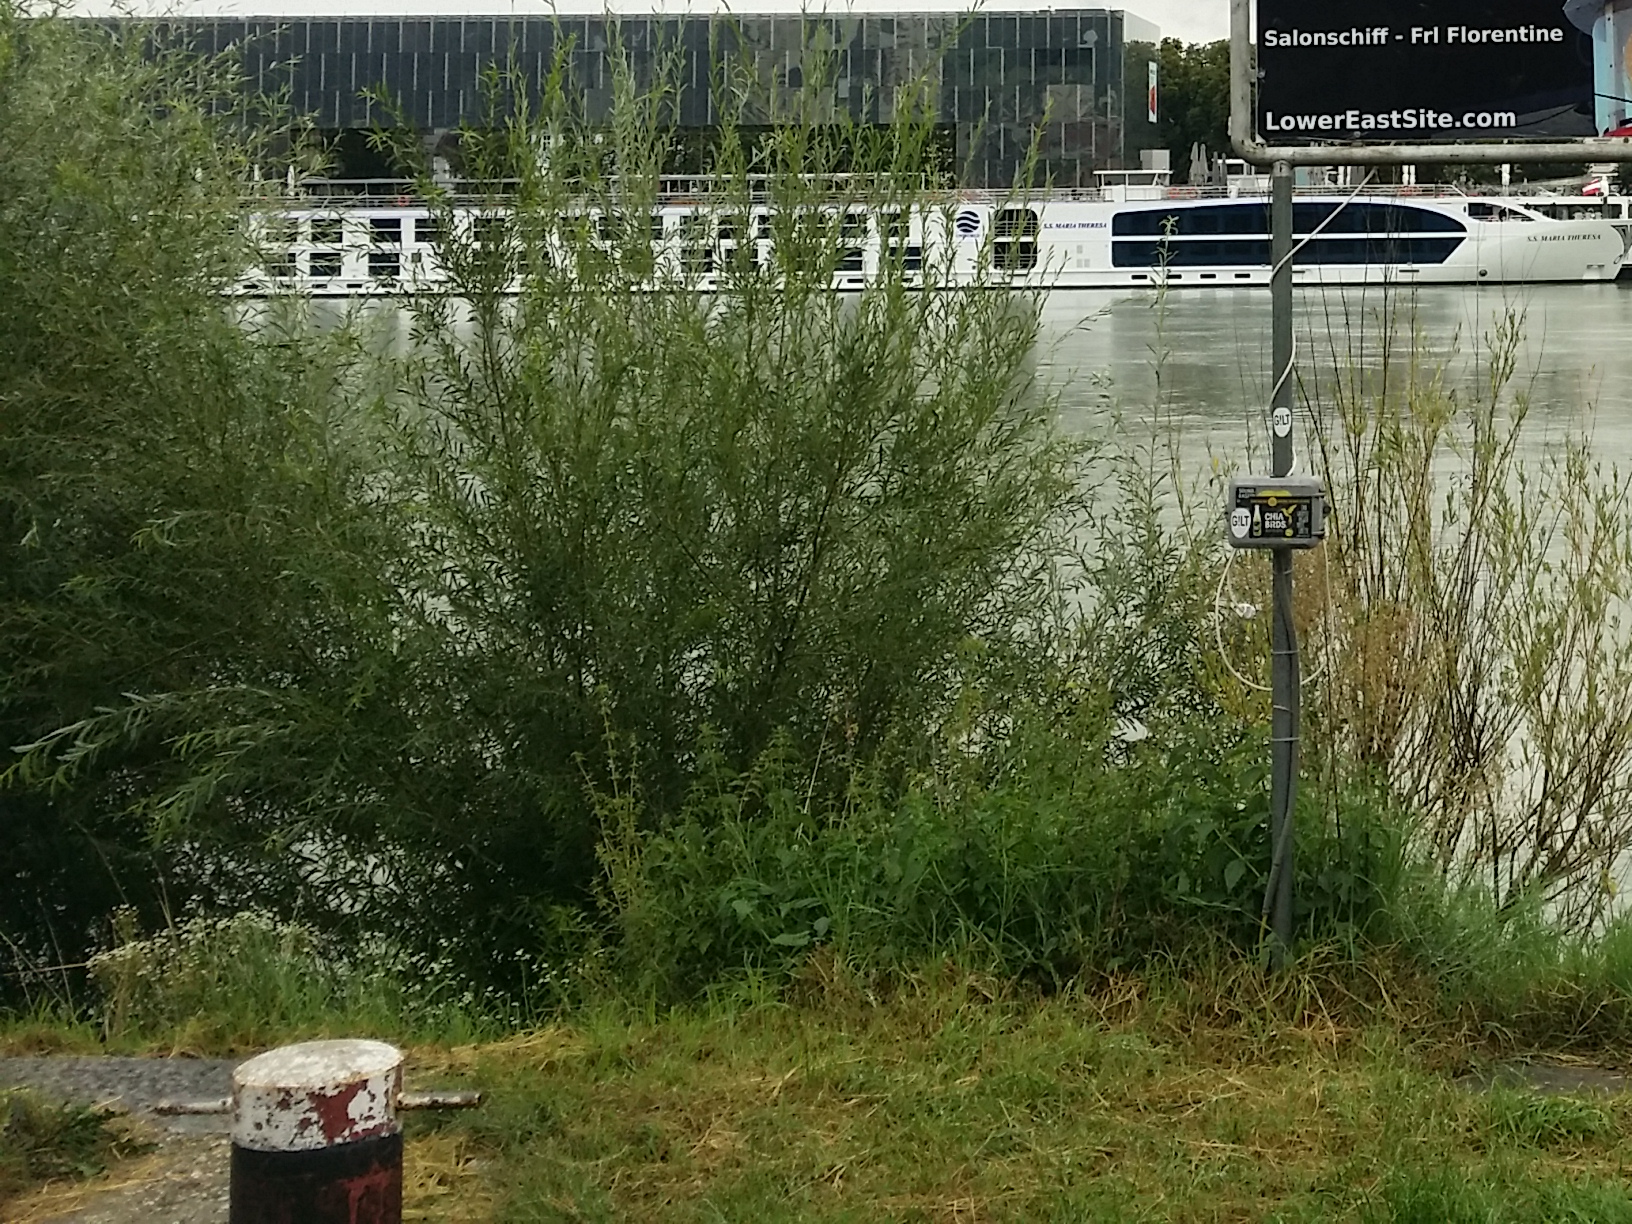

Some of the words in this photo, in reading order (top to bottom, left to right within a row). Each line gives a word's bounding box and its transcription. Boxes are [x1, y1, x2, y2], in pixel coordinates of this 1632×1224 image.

[1264, 28, 1389, 47] Salonschiff
[1411, 27, 1439, 44] Frl
[1447, 25, 1564, 44] Florentine
[1265, 108, 1516, 131] LowerEastSite.com
[1264, 512, 1284, 521] CHIA
